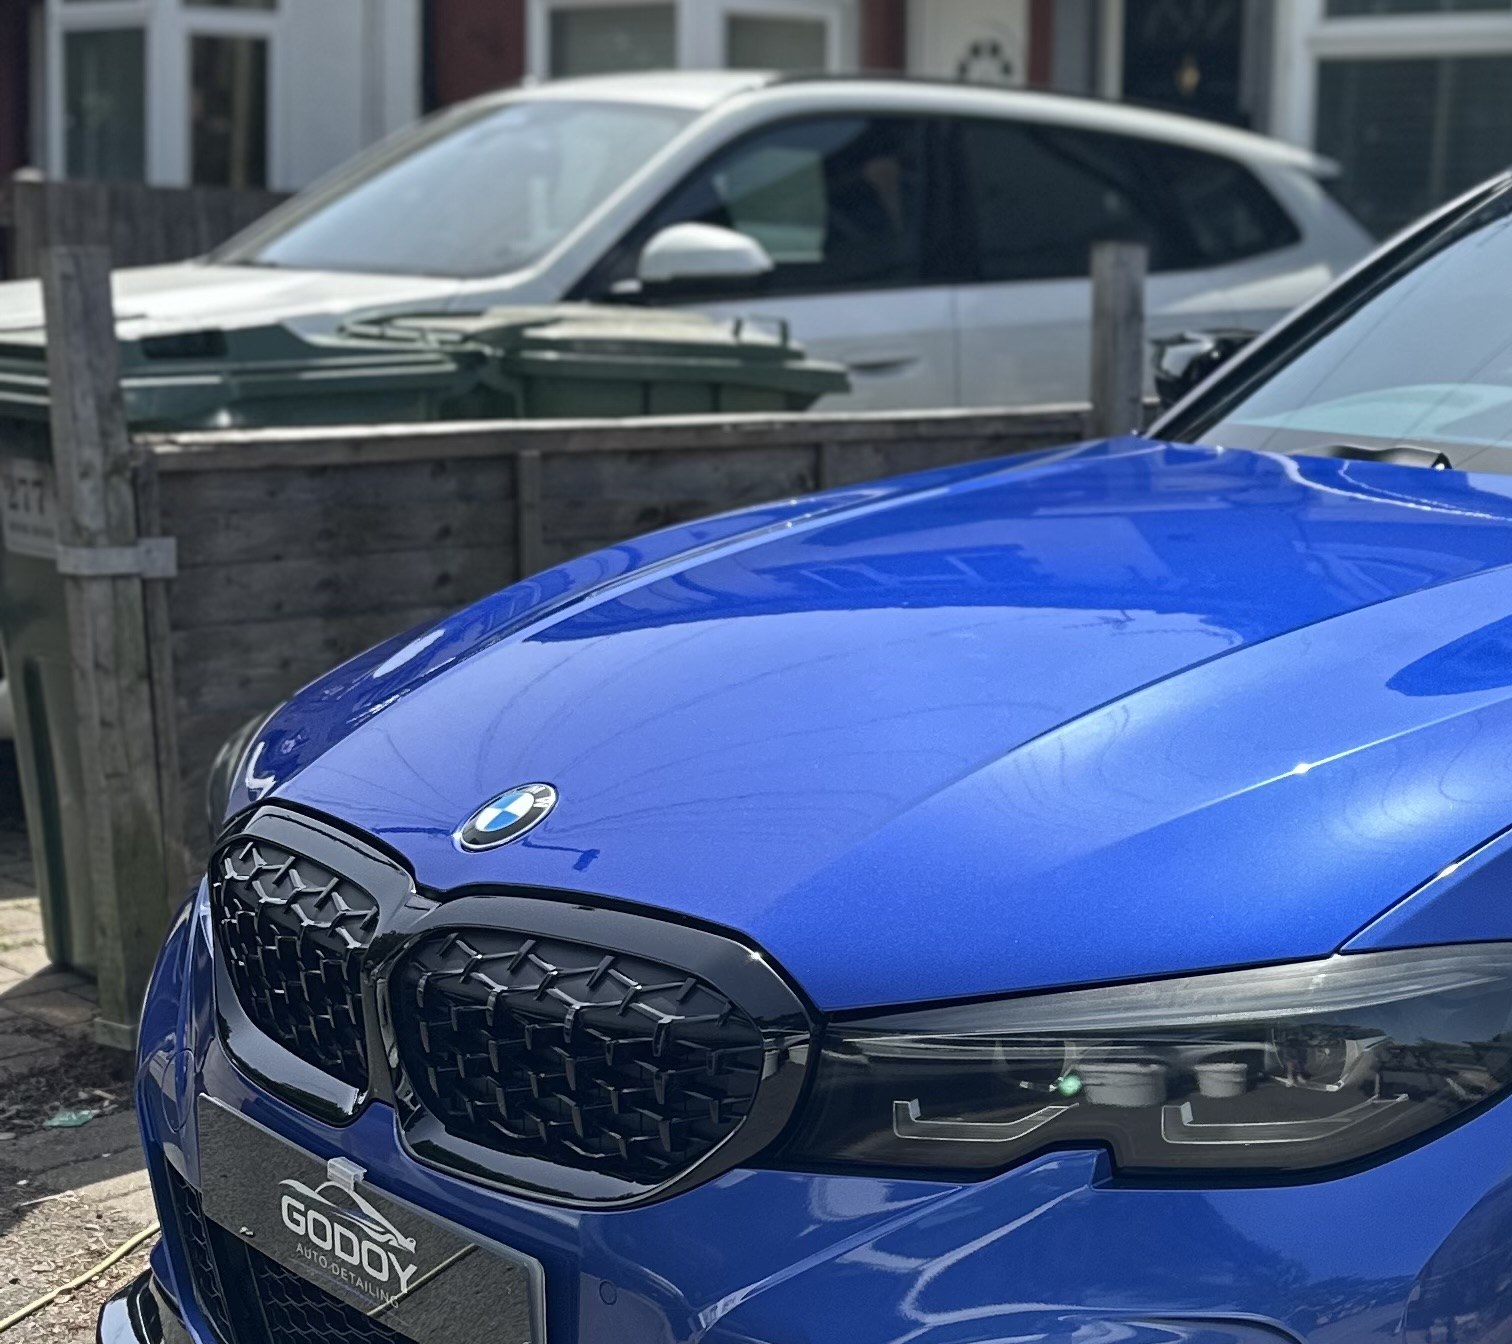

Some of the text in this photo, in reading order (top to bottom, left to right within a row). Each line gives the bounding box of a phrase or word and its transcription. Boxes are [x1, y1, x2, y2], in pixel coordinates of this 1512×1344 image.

[281, 1195, 418, 1294] GODOY
[296, 1242, 399, 1309] AUTO DETAILING
